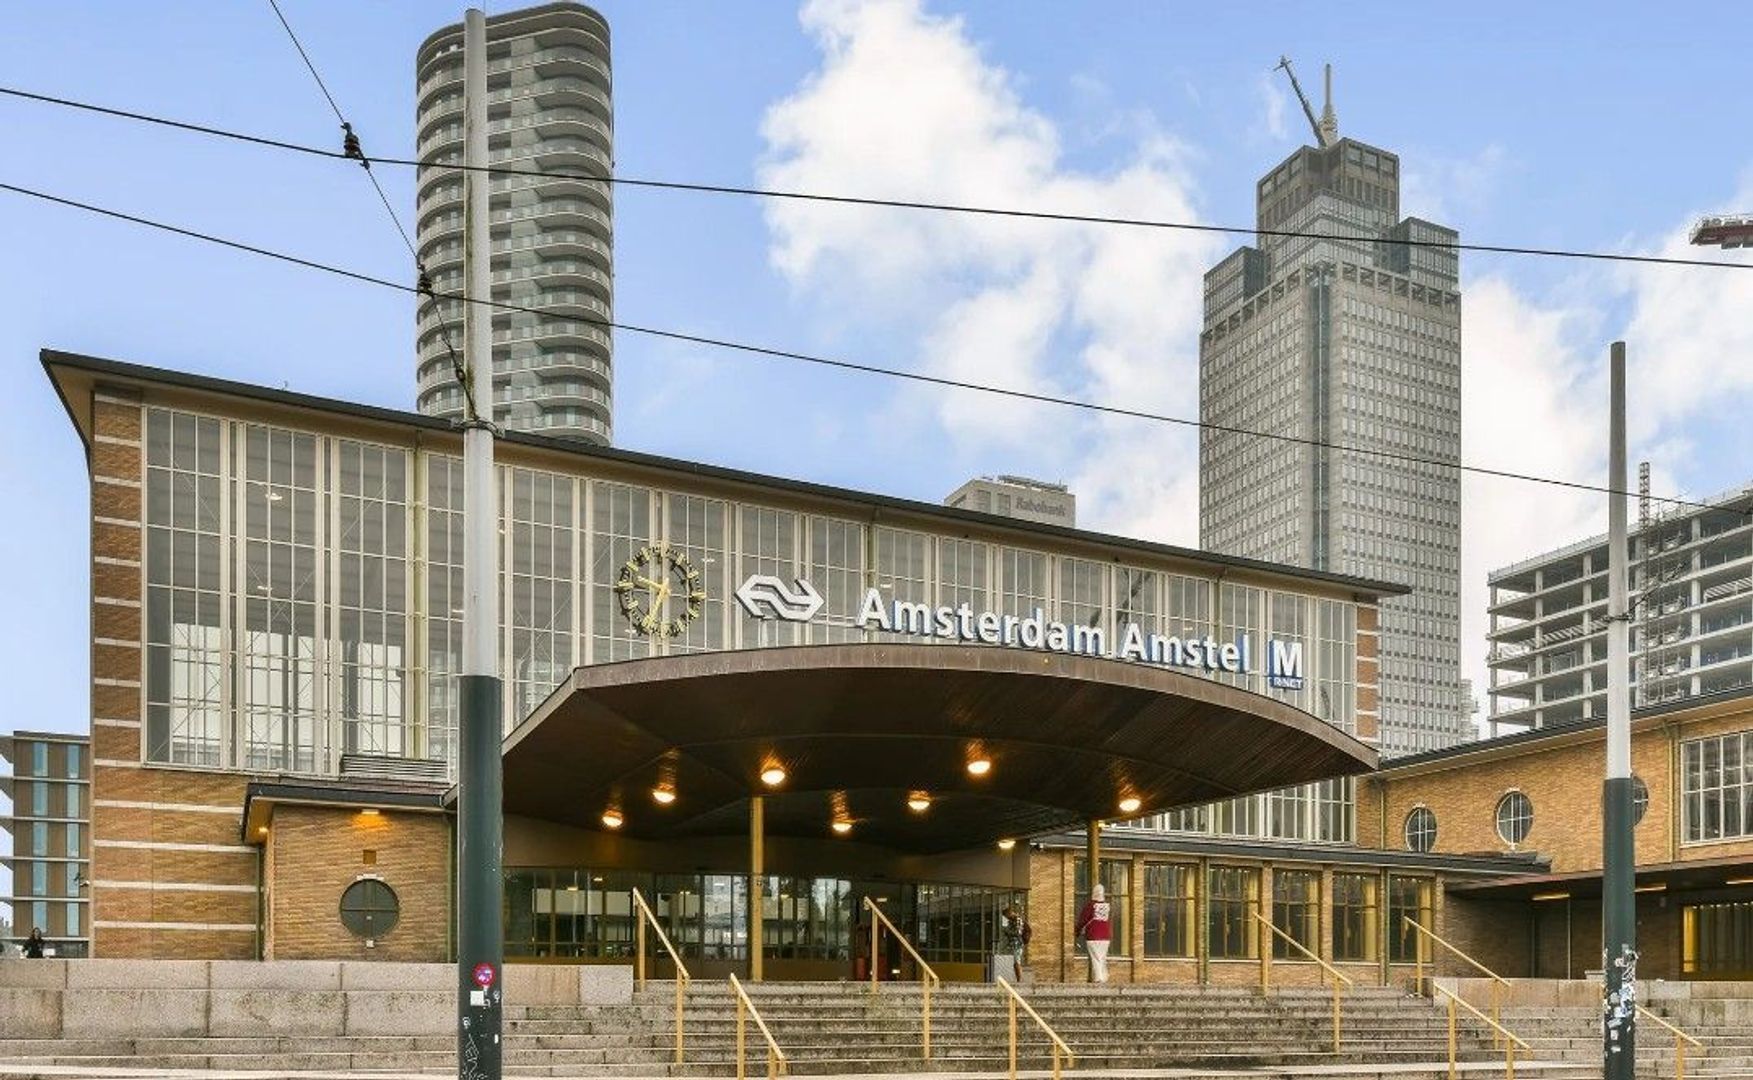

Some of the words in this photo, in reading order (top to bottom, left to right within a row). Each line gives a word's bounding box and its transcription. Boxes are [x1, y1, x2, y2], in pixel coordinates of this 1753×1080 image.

[857, 588, 1106, 653] Amsterdam
[1121, 623, 1251, 673] Amstel
[1272, 640, 1303, 677] M
